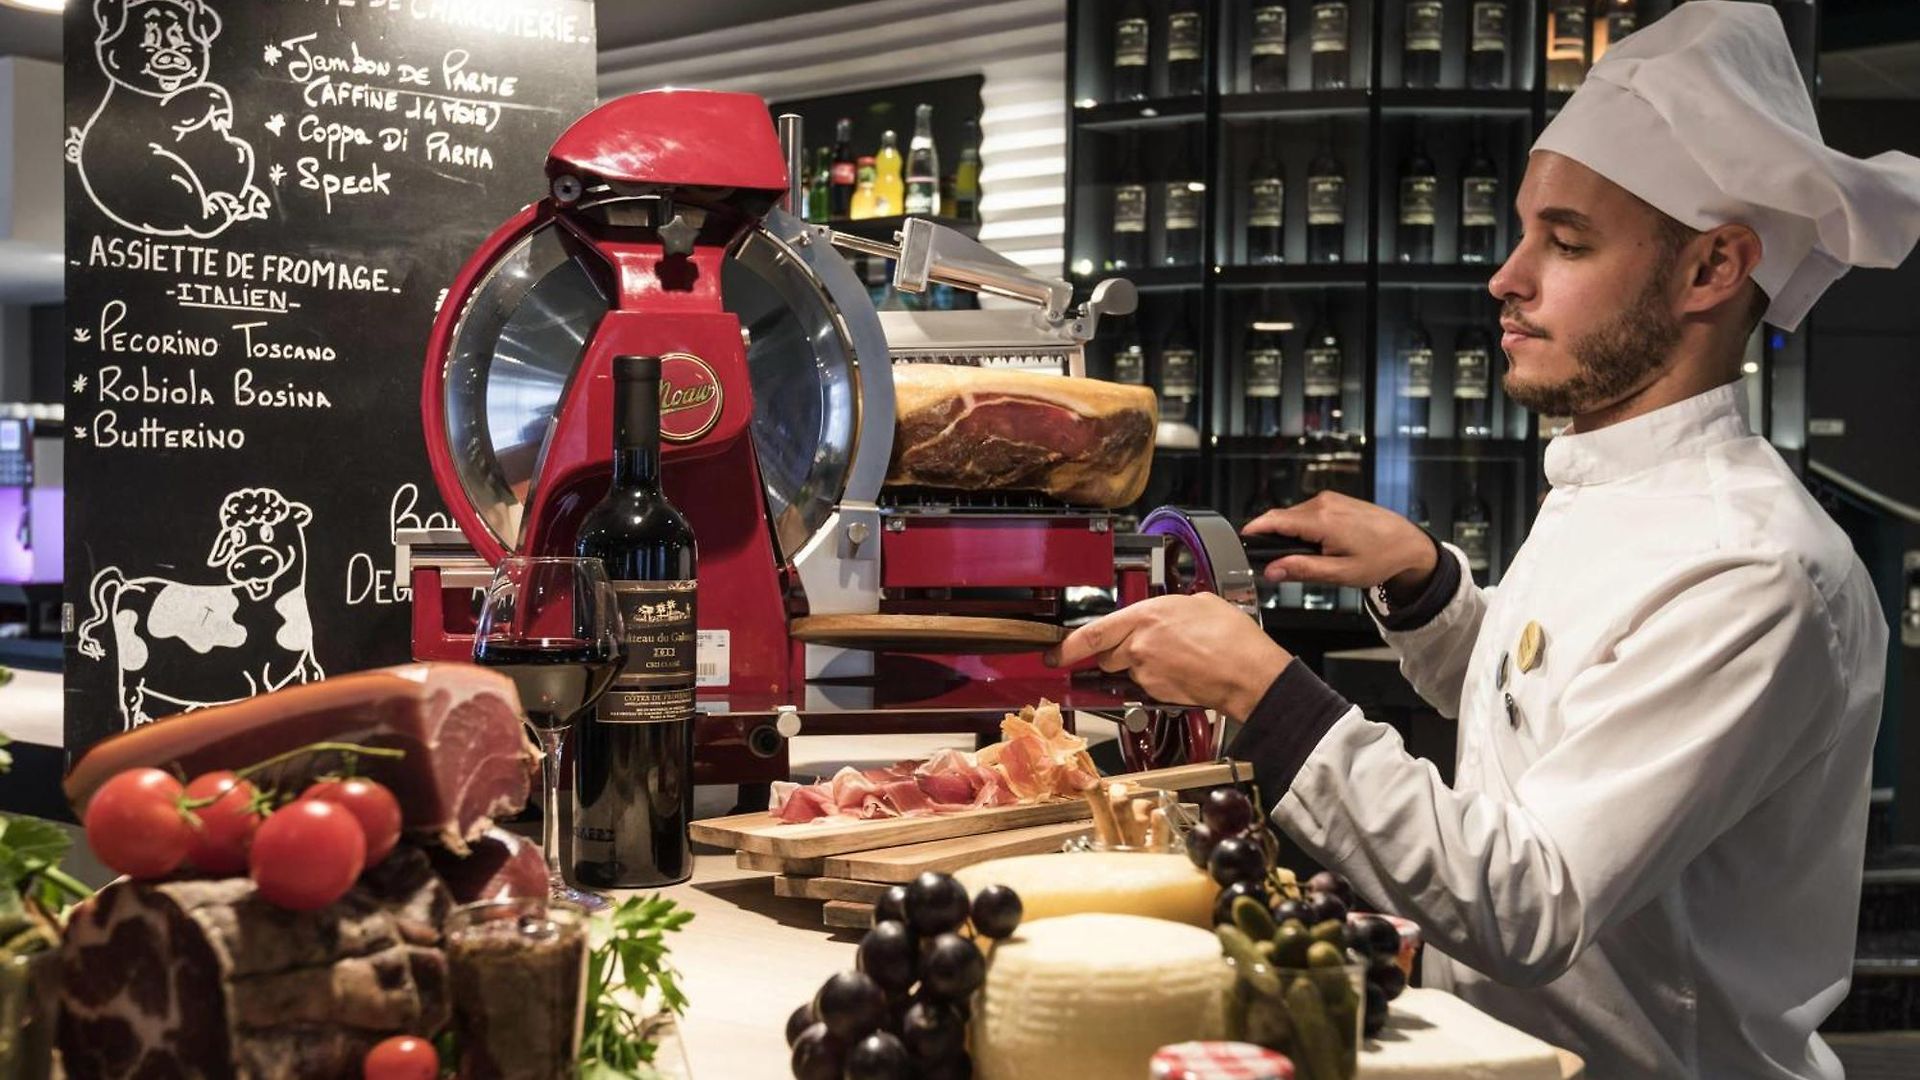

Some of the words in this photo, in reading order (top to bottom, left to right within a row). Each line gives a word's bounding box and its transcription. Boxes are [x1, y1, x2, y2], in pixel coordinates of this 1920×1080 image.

[398, 64, 430, 85] DE
[443, 49, 518, 96] PARME
[426, 132, 493, 170] PARMA
[226, 252, 255, 280] DE
